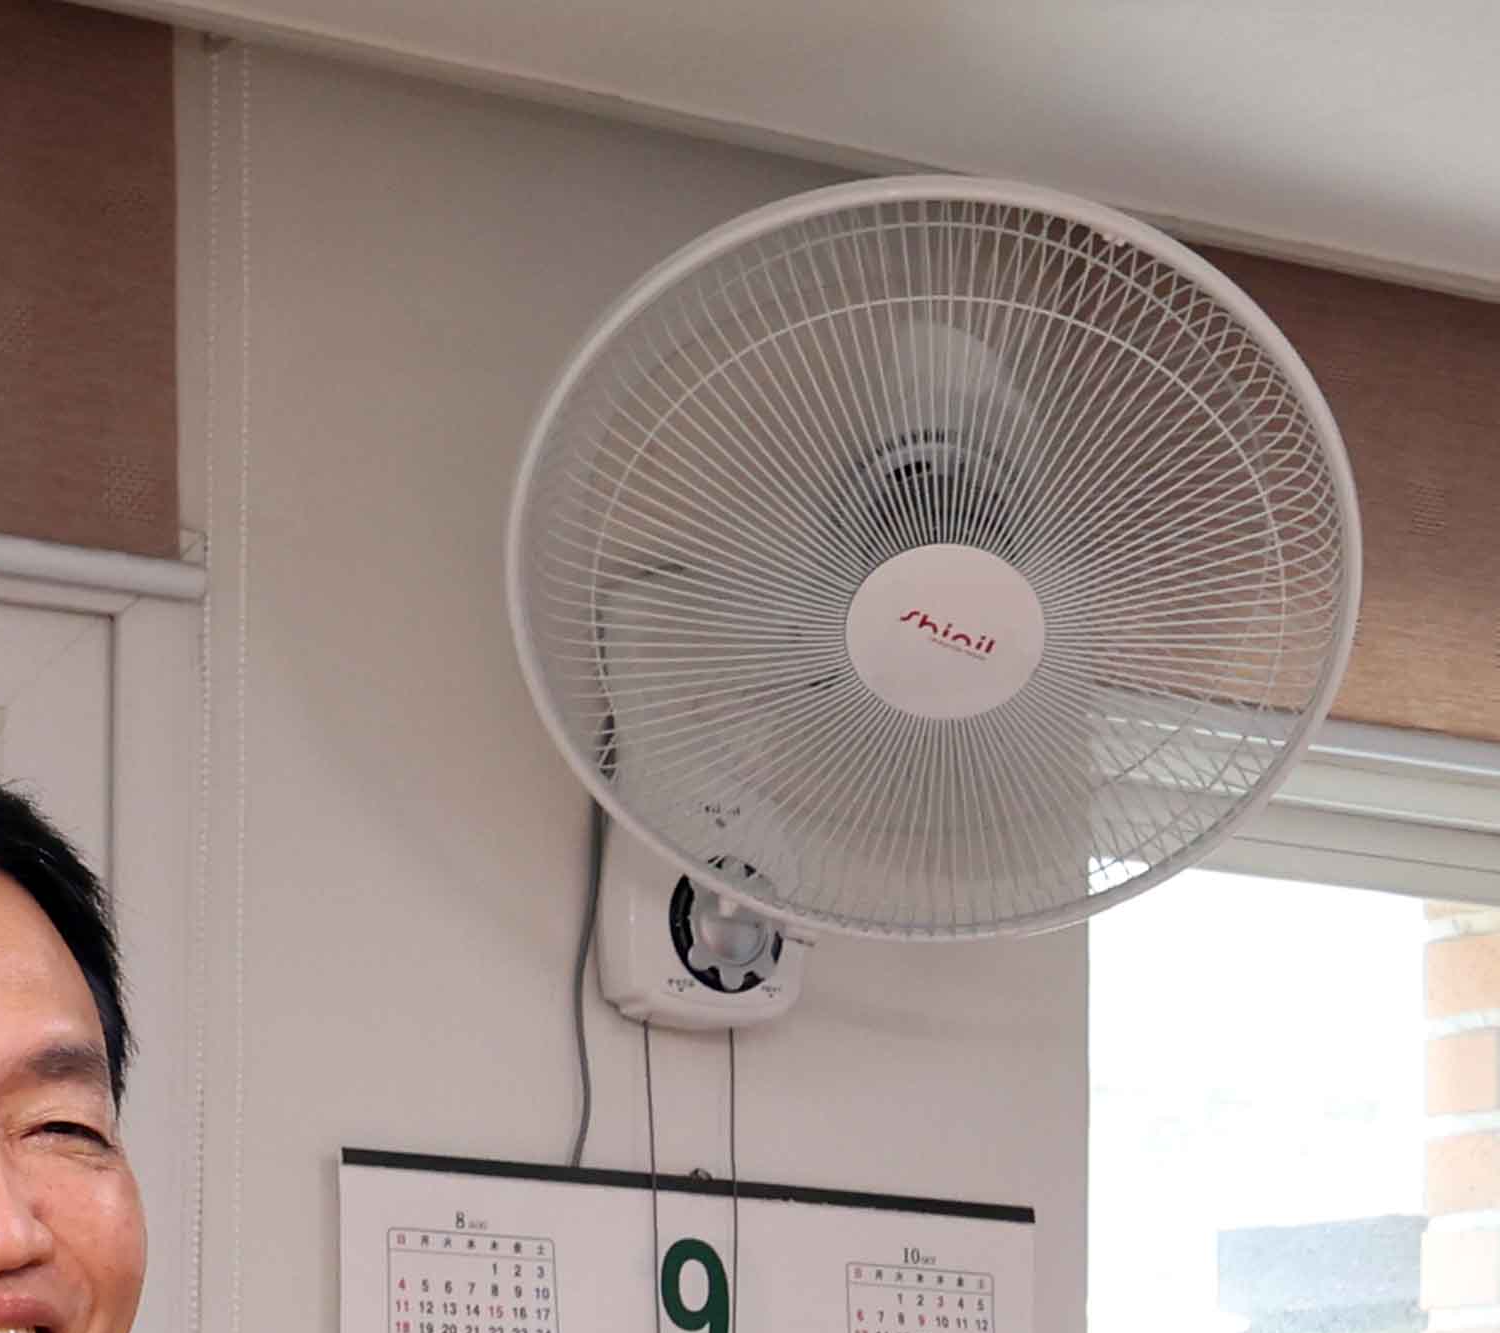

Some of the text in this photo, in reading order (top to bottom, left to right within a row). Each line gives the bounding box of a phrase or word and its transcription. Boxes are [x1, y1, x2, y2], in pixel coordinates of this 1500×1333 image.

[455, 1212, 465, 1228] 8
[903, 1248, 920, 1263] 10
[493, 1263, 544, 1278] 1 2 3
[398, 1279, 549, 1299] 4 5 6 7 8 9 10
[397, 1301, 550, 1320] 11 12 13 14 15 16 17
[897, 1293, 984, 1311] 1 2 3 4 5
[878, 1311, 884, 1322] 7
[936, 1316, 948, 1328] 10
[957, 1318, 968, 1328] 11
[976, 1320, 987, 1331] 12
